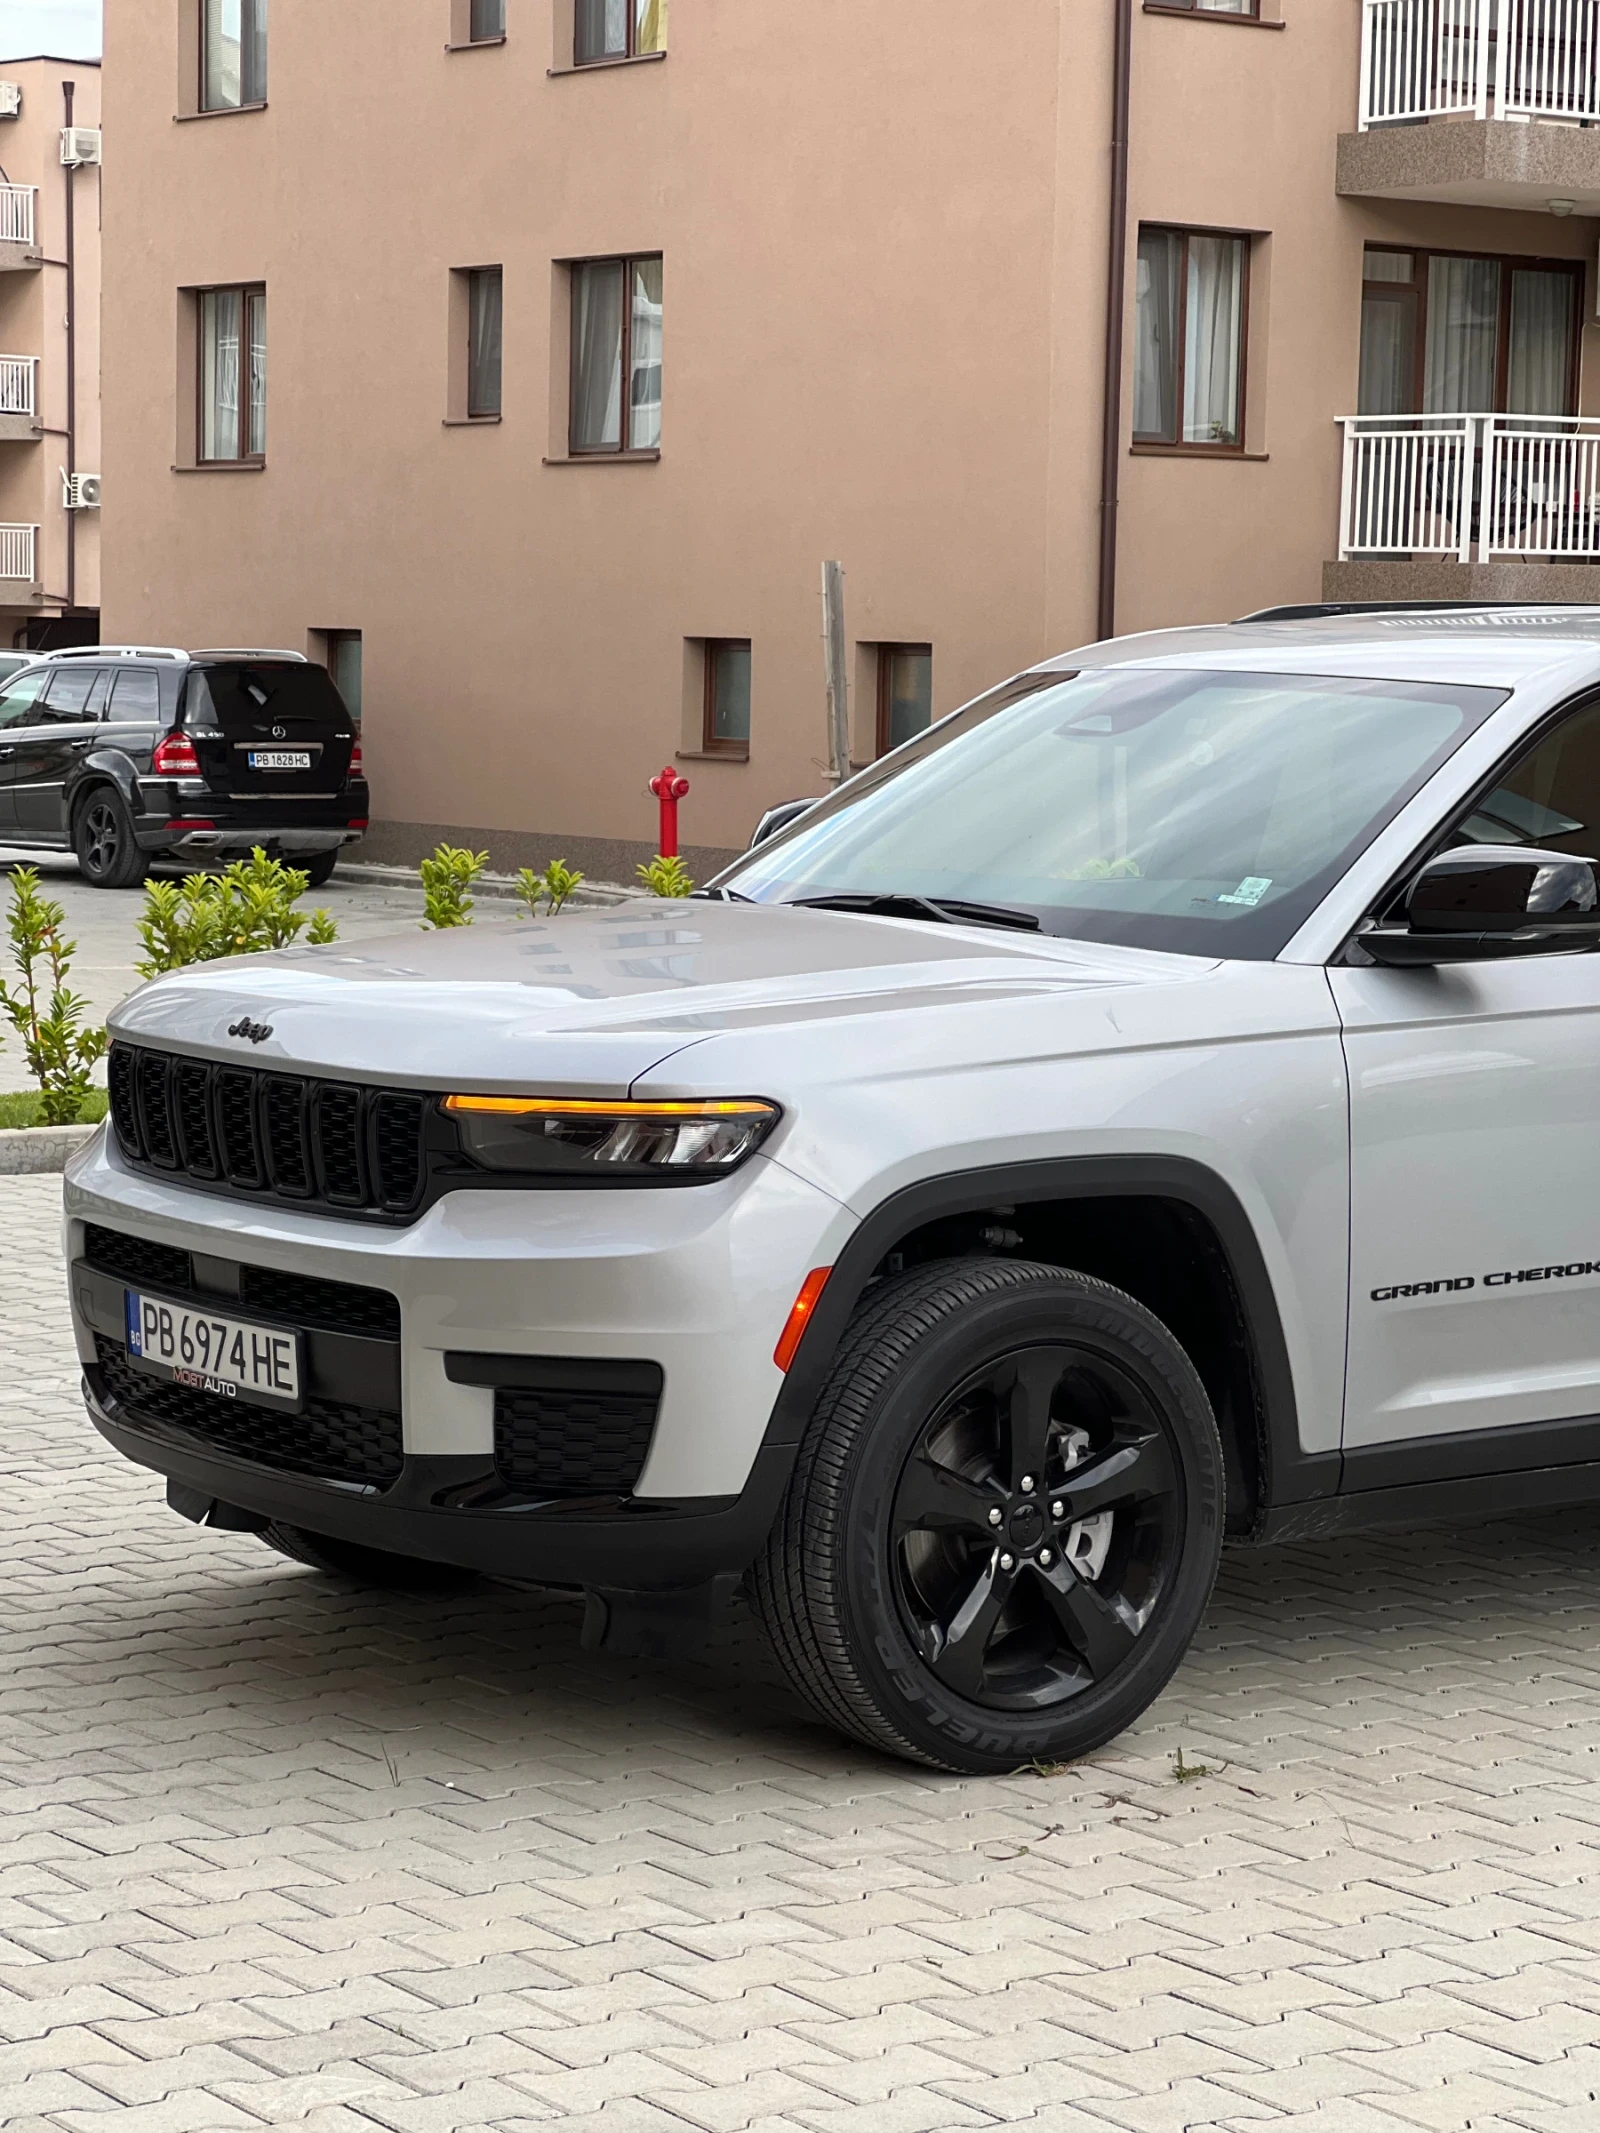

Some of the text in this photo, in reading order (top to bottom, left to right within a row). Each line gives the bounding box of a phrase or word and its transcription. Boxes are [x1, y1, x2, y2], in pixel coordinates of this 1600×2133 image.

[228, 1016, 274, 1044] Jeep
[1370, 1276, 1475, 1301] GRAND
[130, 1330, 141, 1346] BG
